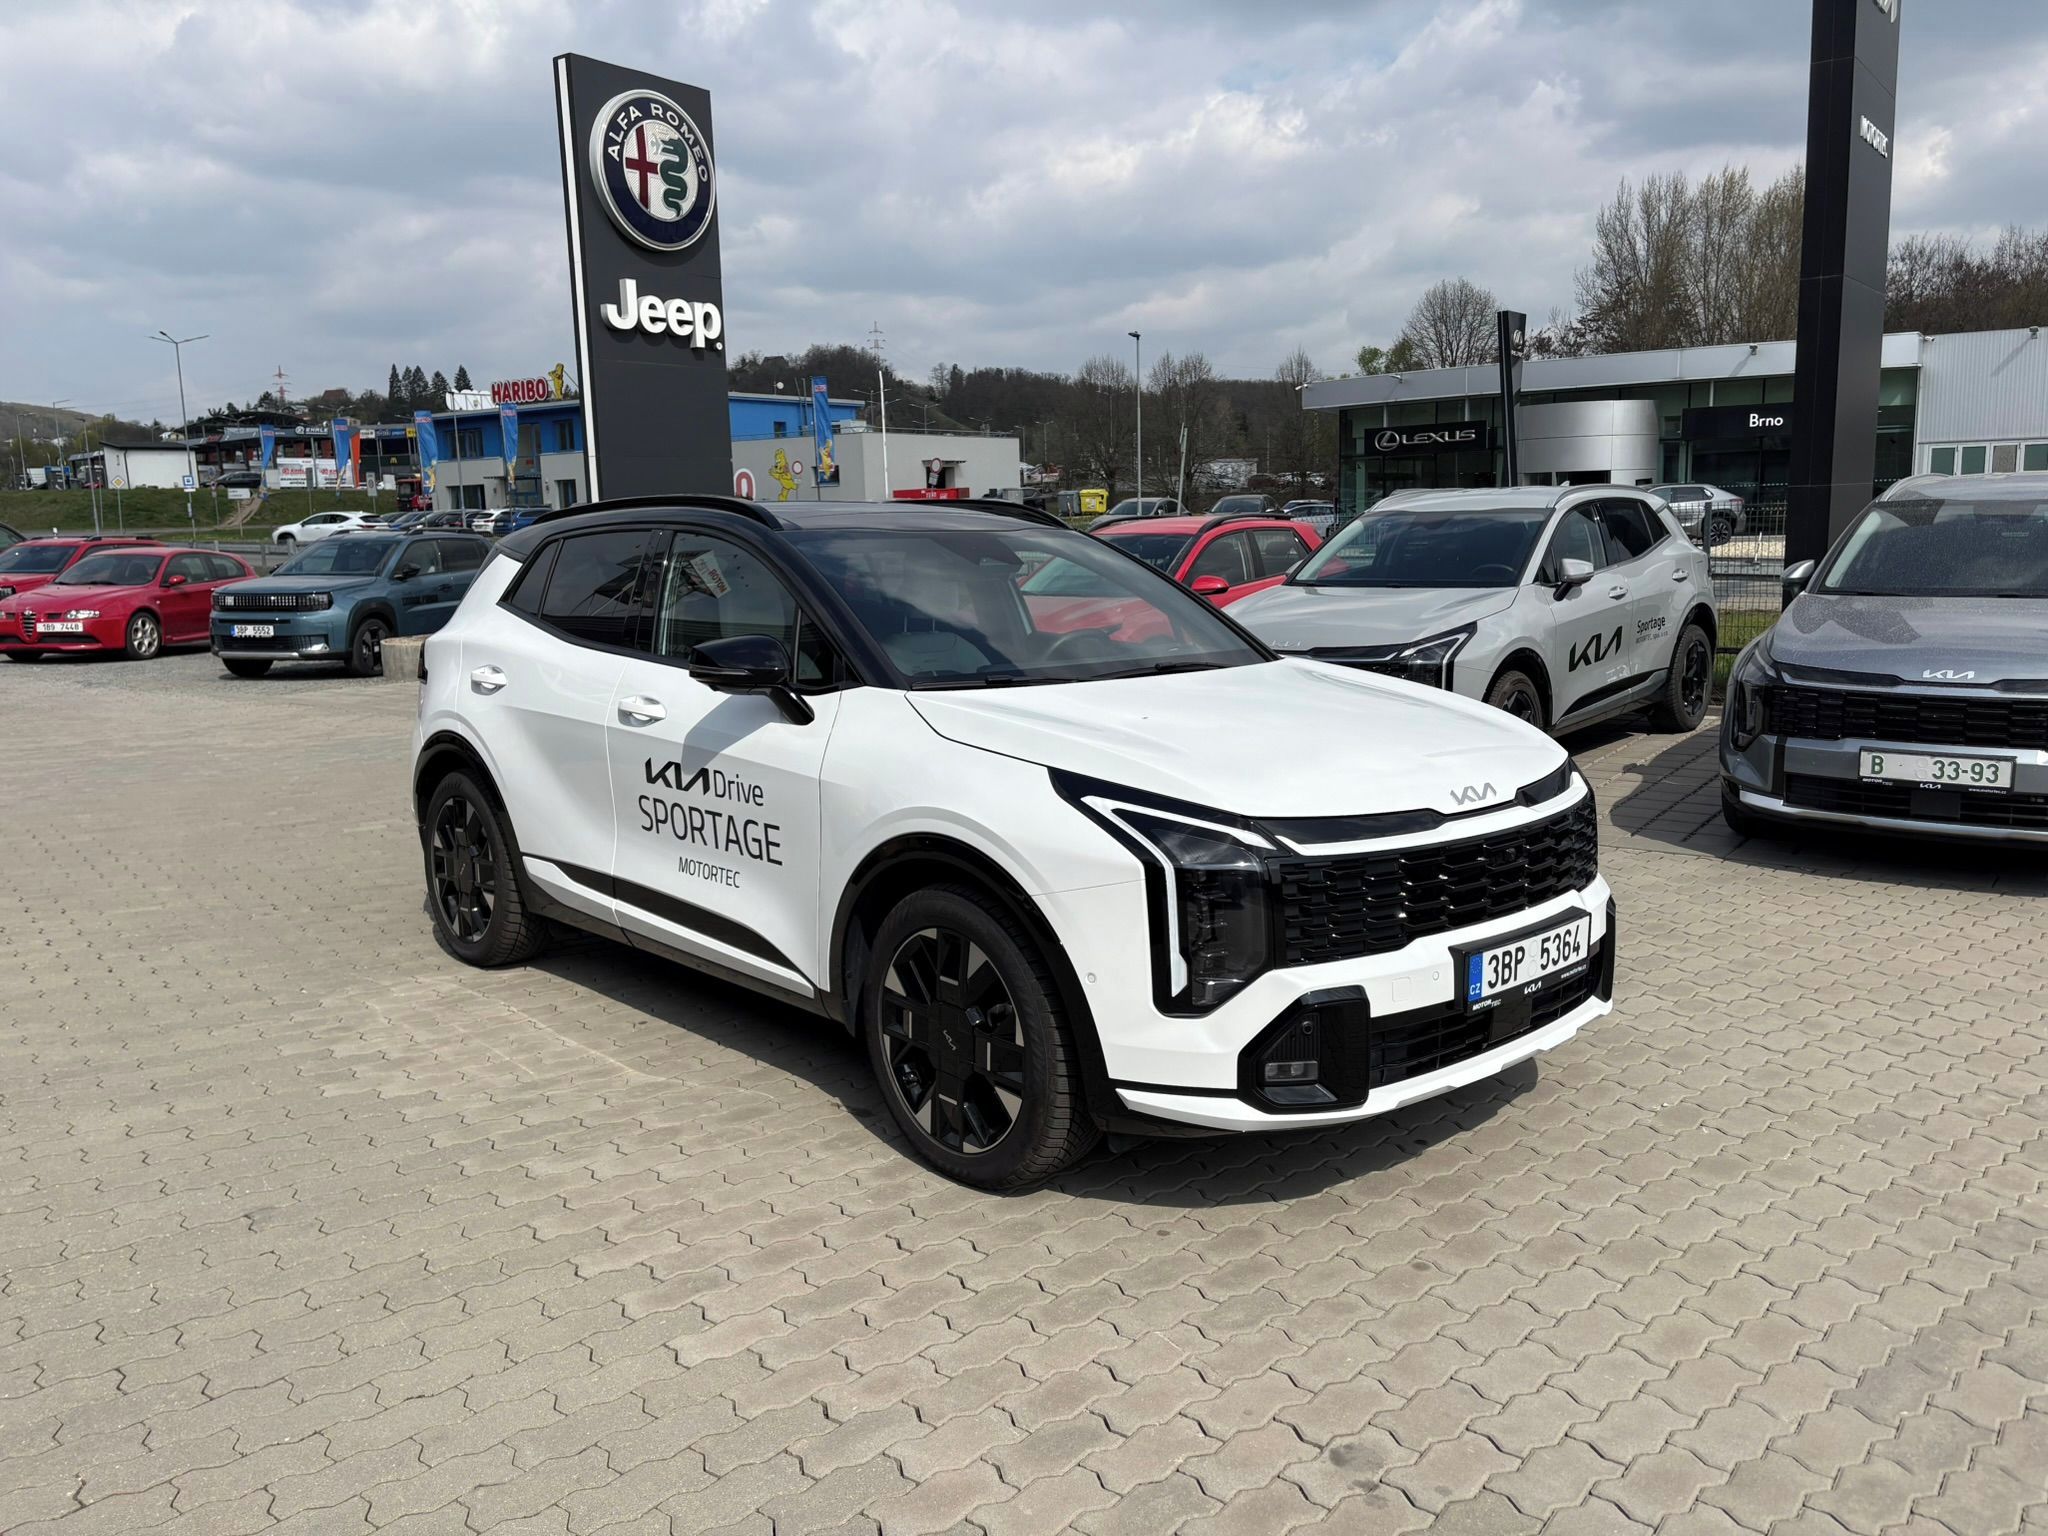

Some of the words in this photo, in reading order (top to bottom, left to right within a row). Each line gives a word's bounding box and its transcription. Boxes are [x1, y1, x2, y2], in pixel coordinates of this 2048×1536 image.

[607, 104, 643, 162] ALFA
[650, 102, 709, 183] ROMEO
[600, 277, 722, 348] Jeep
[491, 377, 548, 404] HARIBO
[1749, 413, 1784, 427] Brno
[1401, 429, 1476, 444] LEXUS
[252, 626, 271, 635] 5552
[1636, 616, 1666, 635] Sportage
[1568, 625, 1623, 672] KIA
[1922, 669, 1975, 679] KIA
[645, 757, 711, 795] KIA
[713, 769, 764, 806] Drive
[1871, 755, 1884, 775] B
[1931, 759, 1999, 784] 33-93
[1450, 782, 1497, 805] KIA
[1919, 782, 1941, 790] KIA
[638, 794, 783, 866] SPORTAGE
[678, 856, 741, 888] MOTORTEC
[1487, 945, 1526, 989] 3BP
[1540, 924, 1581, 971] 5364
[1469, 982, 1481, 995] CZ
[1524, 980, 1542, 994] KIA
